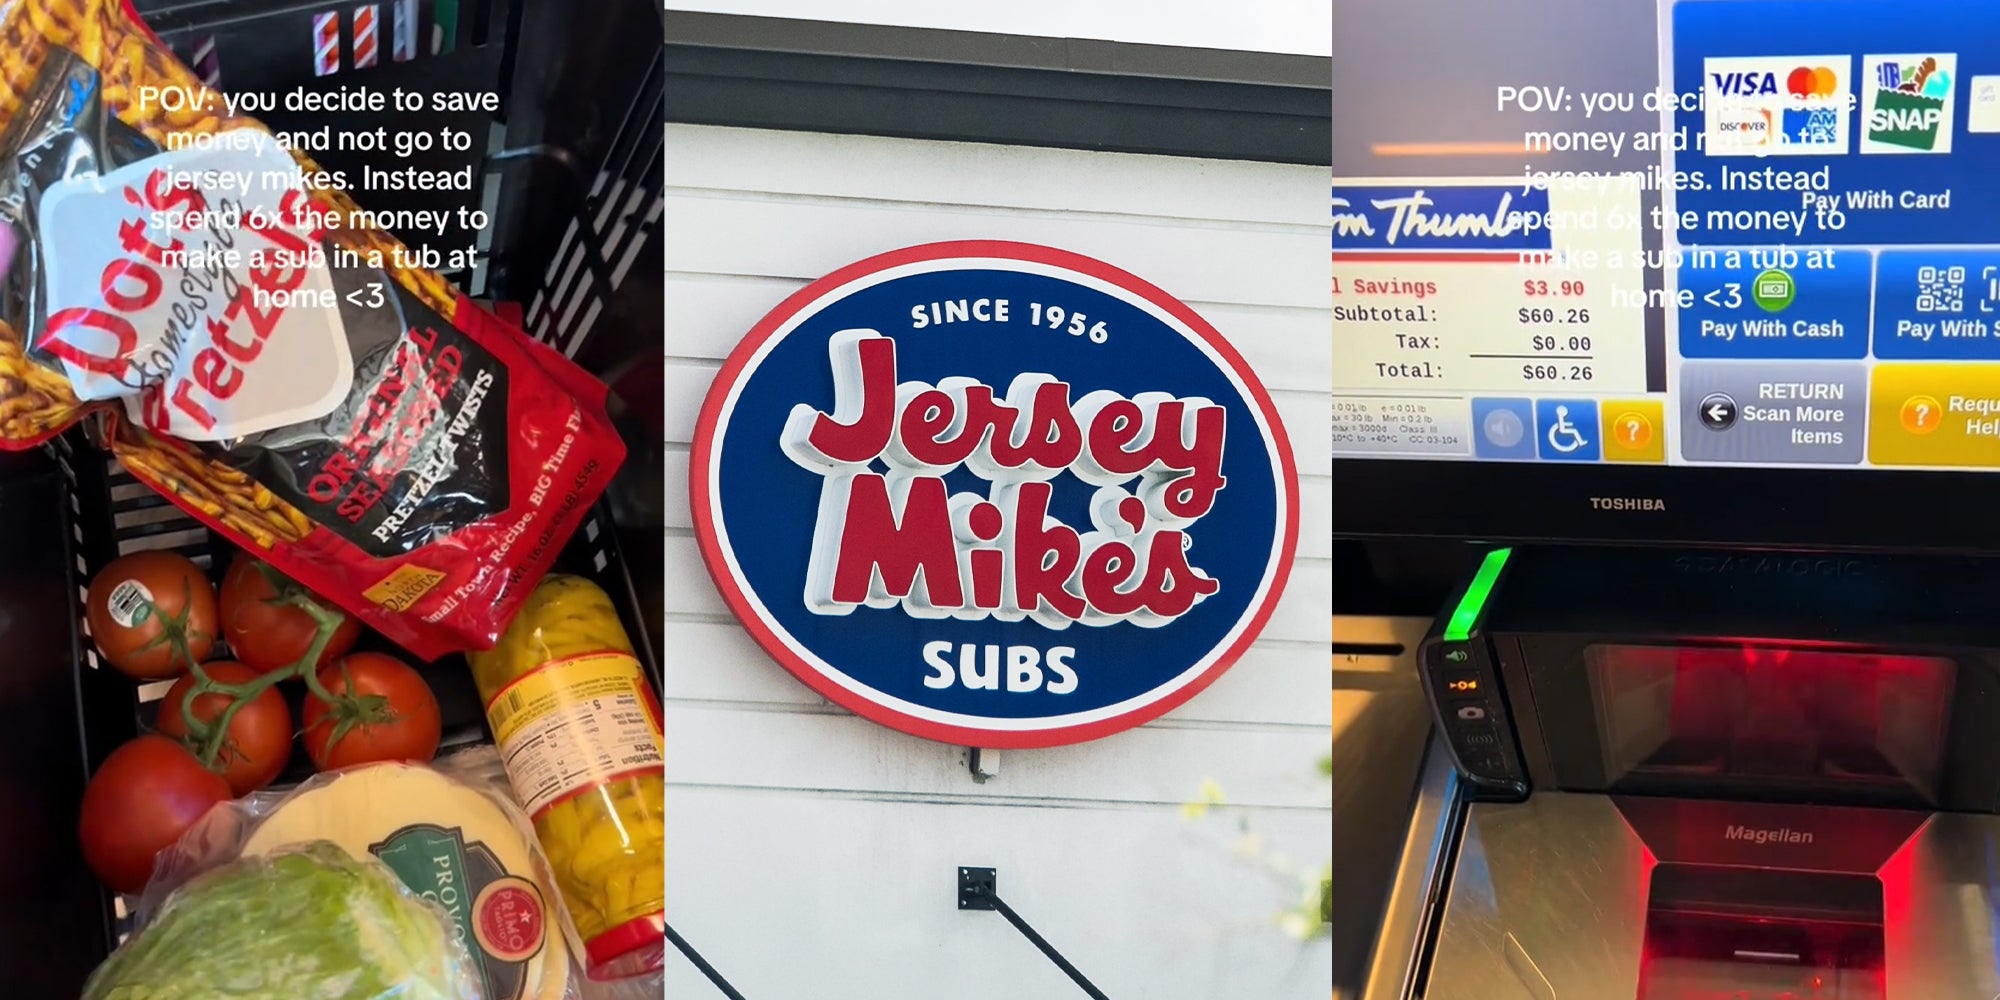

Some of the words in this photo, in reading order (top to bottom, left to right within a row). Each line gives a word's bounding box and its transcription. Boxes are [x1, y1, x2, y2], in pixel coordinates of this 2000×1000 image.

[1710, 72, 1778, 96] VISA
[1719, 120, 1767, 132] DISCOVER
[1807, 112, 1837, 126] AM
[1870, 108, 1943, 132] SNAP
[1802, 191, 1841, 212] Pay
[1845, 190, 1893, 209] With
[1899, 189, 1951, 209] Card
[35, 168, 207, 380] Dot's
[1353, 277, 1438, 299] Savings
[1523, 279, 1586, 300] $3.90
[911, 298, 1010, 329] SINCE
[1028, 303, 1109, 345] 1956
[1333, 305, 1438, 323] Subtotal:
[1518, 307, 1591, 325] $60.26
[1700, 320, 1738, 342] Pay
[1743, 319, 1787, 338] With
[1792, 319, 1845, 338] Cash
[1896, 320, 1936, 342] Pay
[1941, 319, 1987, 338] With
[1395, 333, 1440, 350] Tax:
[1532, 336, 1592, 352] $0.00
[1375, 362, 1443, 379] Total:
[1522, 365, 1593, 382] $60.26
[1758, 383, 1844, 400] RETURN
[803, 332, 1228, 519] Jersey
[1743, 405, 1791, 422] Scan
[1795, 406, 1845, 423] More
[1790, 428, 1844, 445] Items
[371, 450, 450, 544] PRETZEL
[439, 369, 494, 452] TWISTS
[1590, 497, 1666, 511] TOSHIBA
[454, 563, 494, 600] Town
[489, 509, 538, 565] Recipe,
[529, 473, 552, 507] BIG
[543, 436, 575, 474] Time
[832, 472, 1220, 620] Mike's
[383, 572, 440, 613] DAKOTA
[922, 641, 1079, 694] SUBS
[592, 699, 602, 710] 5
[1725, 825, 1814, 845] Magellan
[433, 855, 468, 946] PROVO
[498, 890, 524, 950] PRIMO
